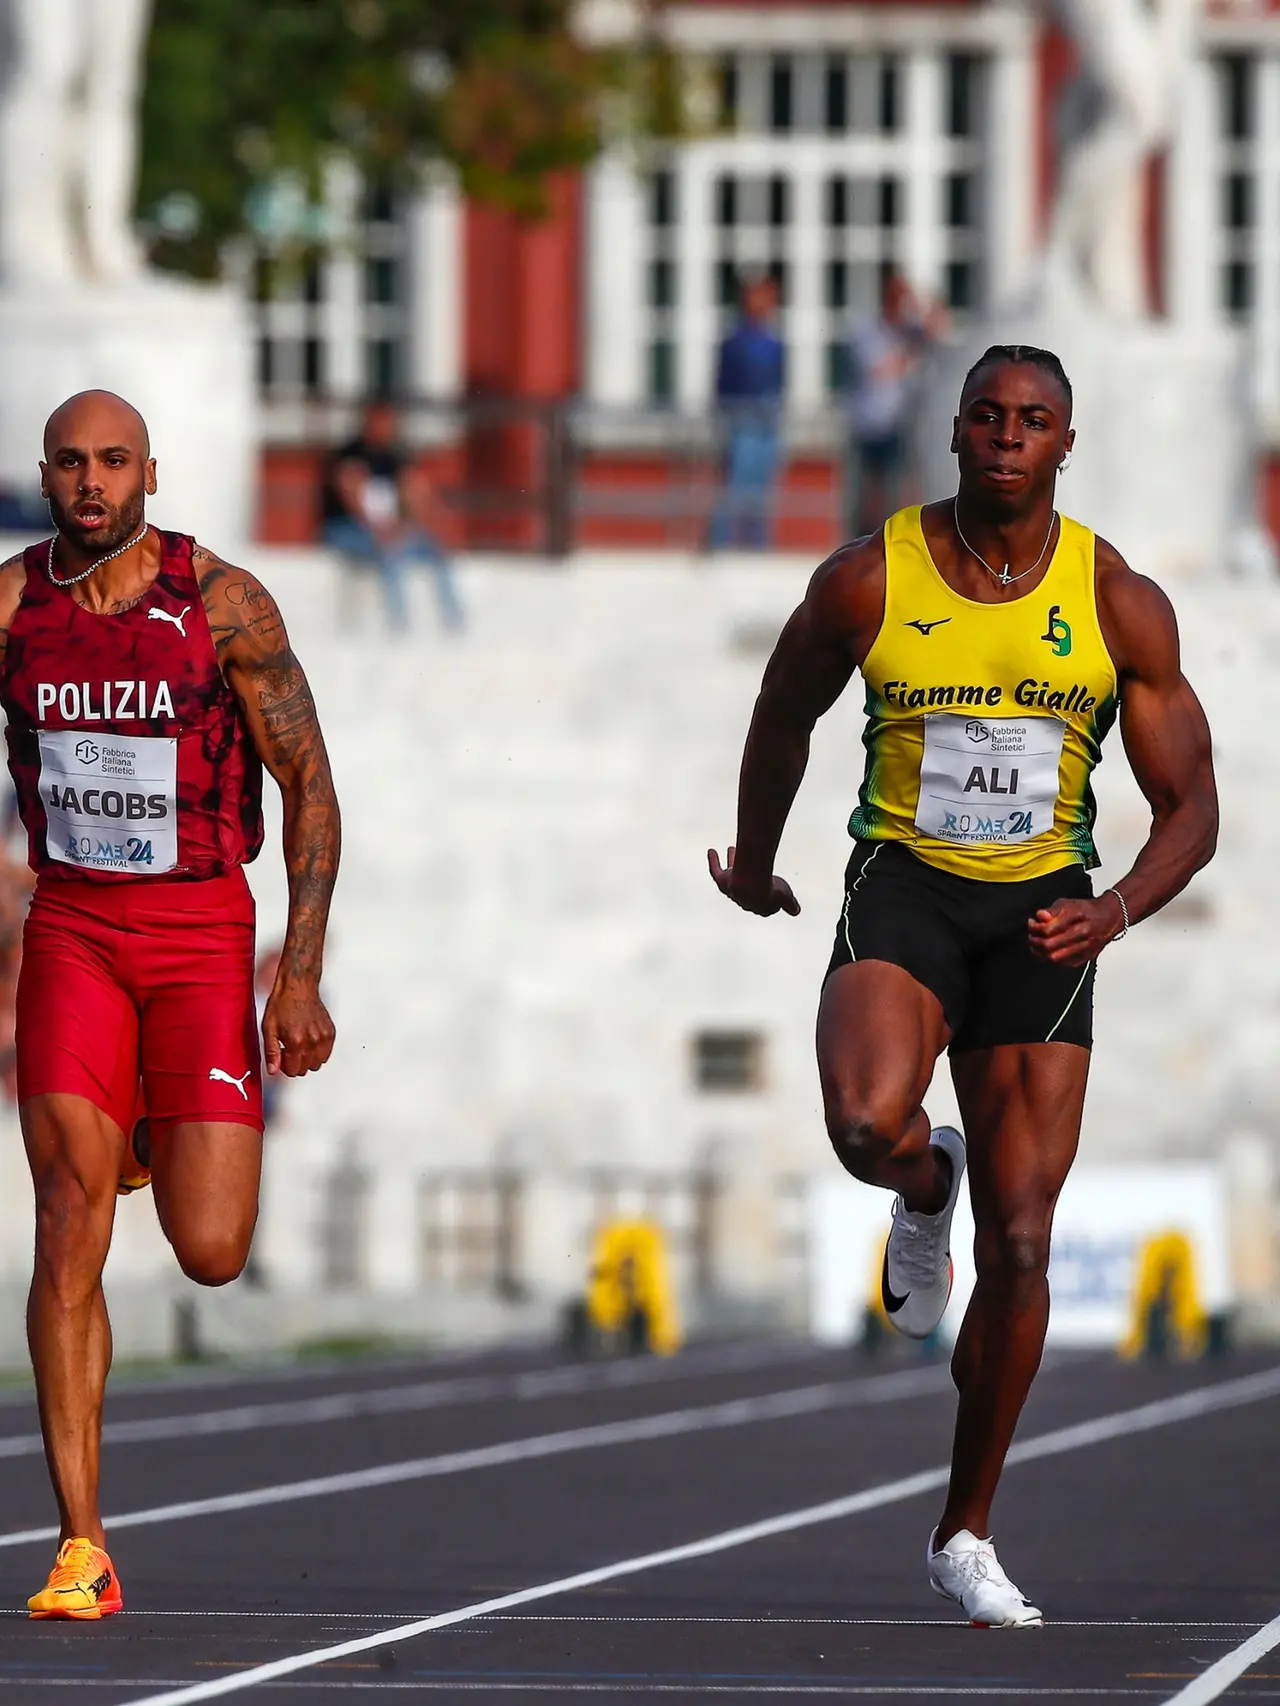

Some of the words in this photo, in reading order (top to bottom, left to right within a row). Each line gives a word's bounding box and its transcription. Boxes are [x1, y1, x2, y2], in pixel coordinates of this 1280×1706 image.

[37, 680, 176, 721] POLIZIA
[883, 681, 1002, 708] Fiamme
[1014, 678, 1098, 713] Gialle
[965, 722, 989, 742] FIS
[991, 735, 1022, 744] Italiana
[992, 727, 1027, 736] Fabbrica
[75, 742, 99, 762] FIS
[102, 747, 136, 759] Fabbrica
[990, 743, 1026, 752] Sintetici
[101, 764, 136, 775] Sintetici
[102, 757, 132, 767] Italiana
[963, 766, 1019, 795] ALI
[49, 784, 167, 820] JACOBS
[1008, 812, 1033, 835] 24
[970, 832, 1008, 842] FESTIVAL
[126, 838, 155, 864] 24
[92, 856, 128, 868] FESTIVAL
